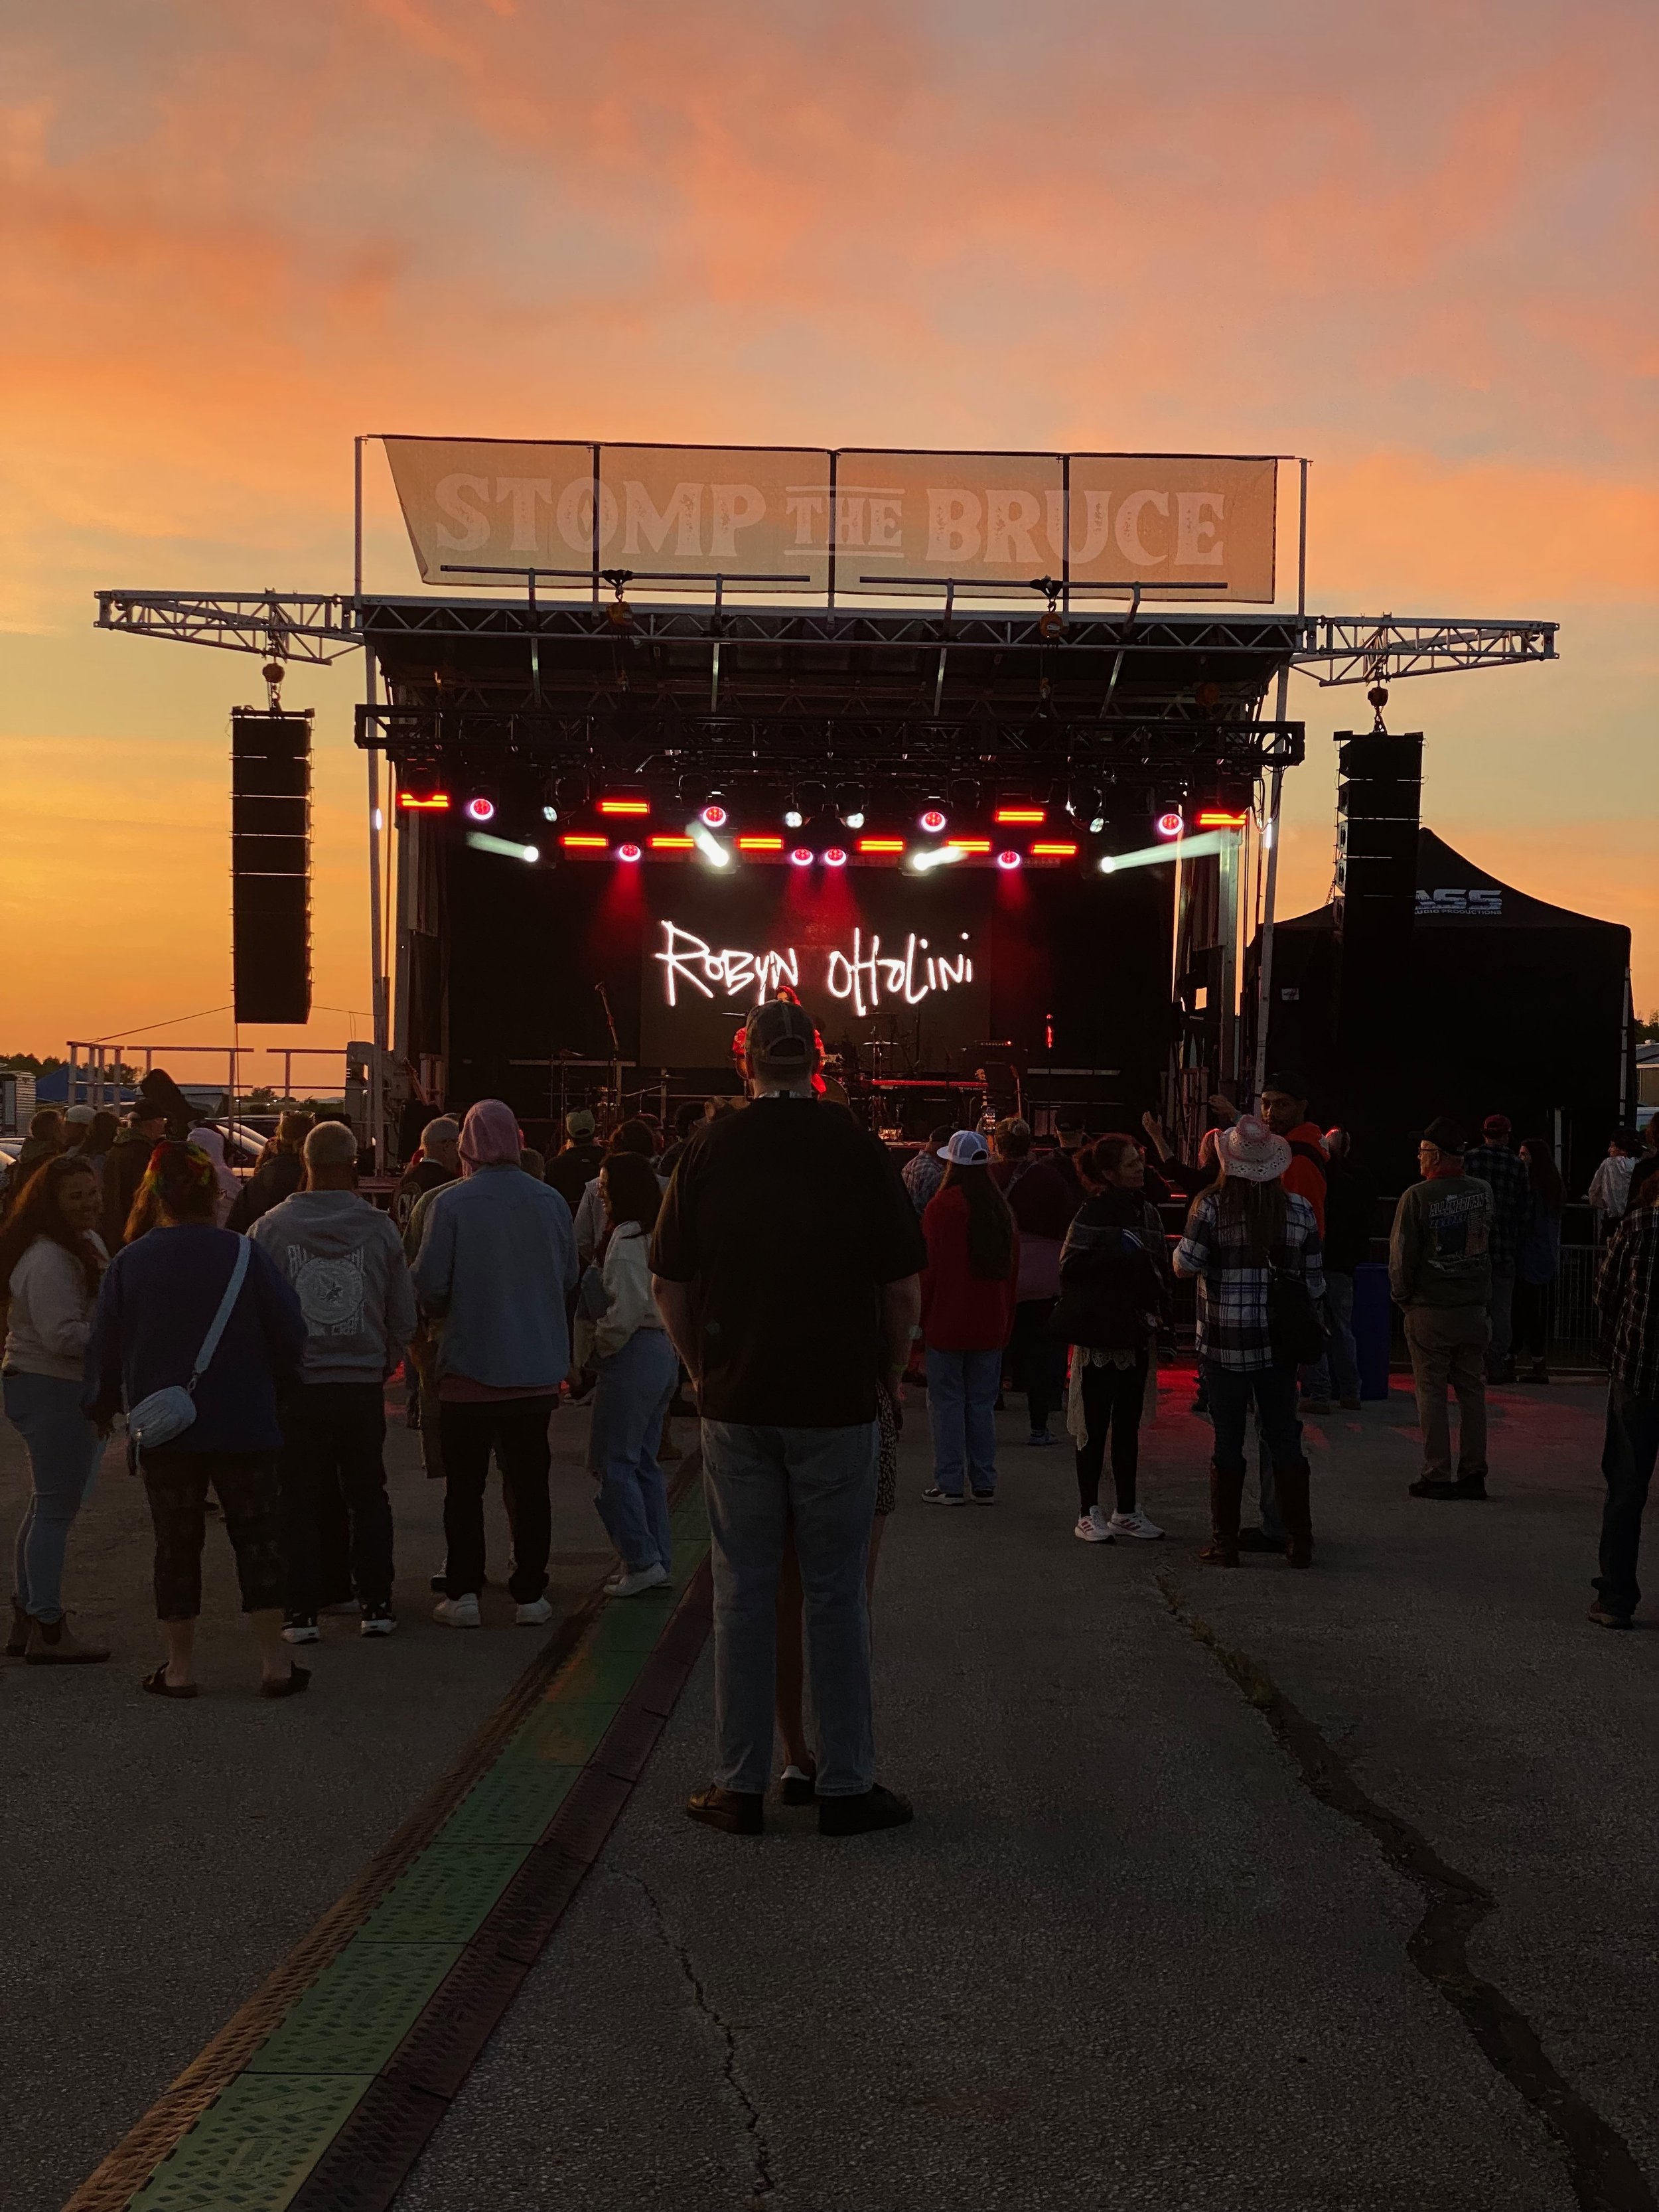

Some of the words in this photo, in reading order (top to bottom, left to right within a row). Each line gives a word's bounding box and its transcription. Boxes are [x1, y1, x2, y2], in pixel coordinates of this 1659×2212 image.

[434, 472, 766, 557] STOMP
[786, 496, 902, 547] THE
[926, 488, 1226, 566] BRUCE
